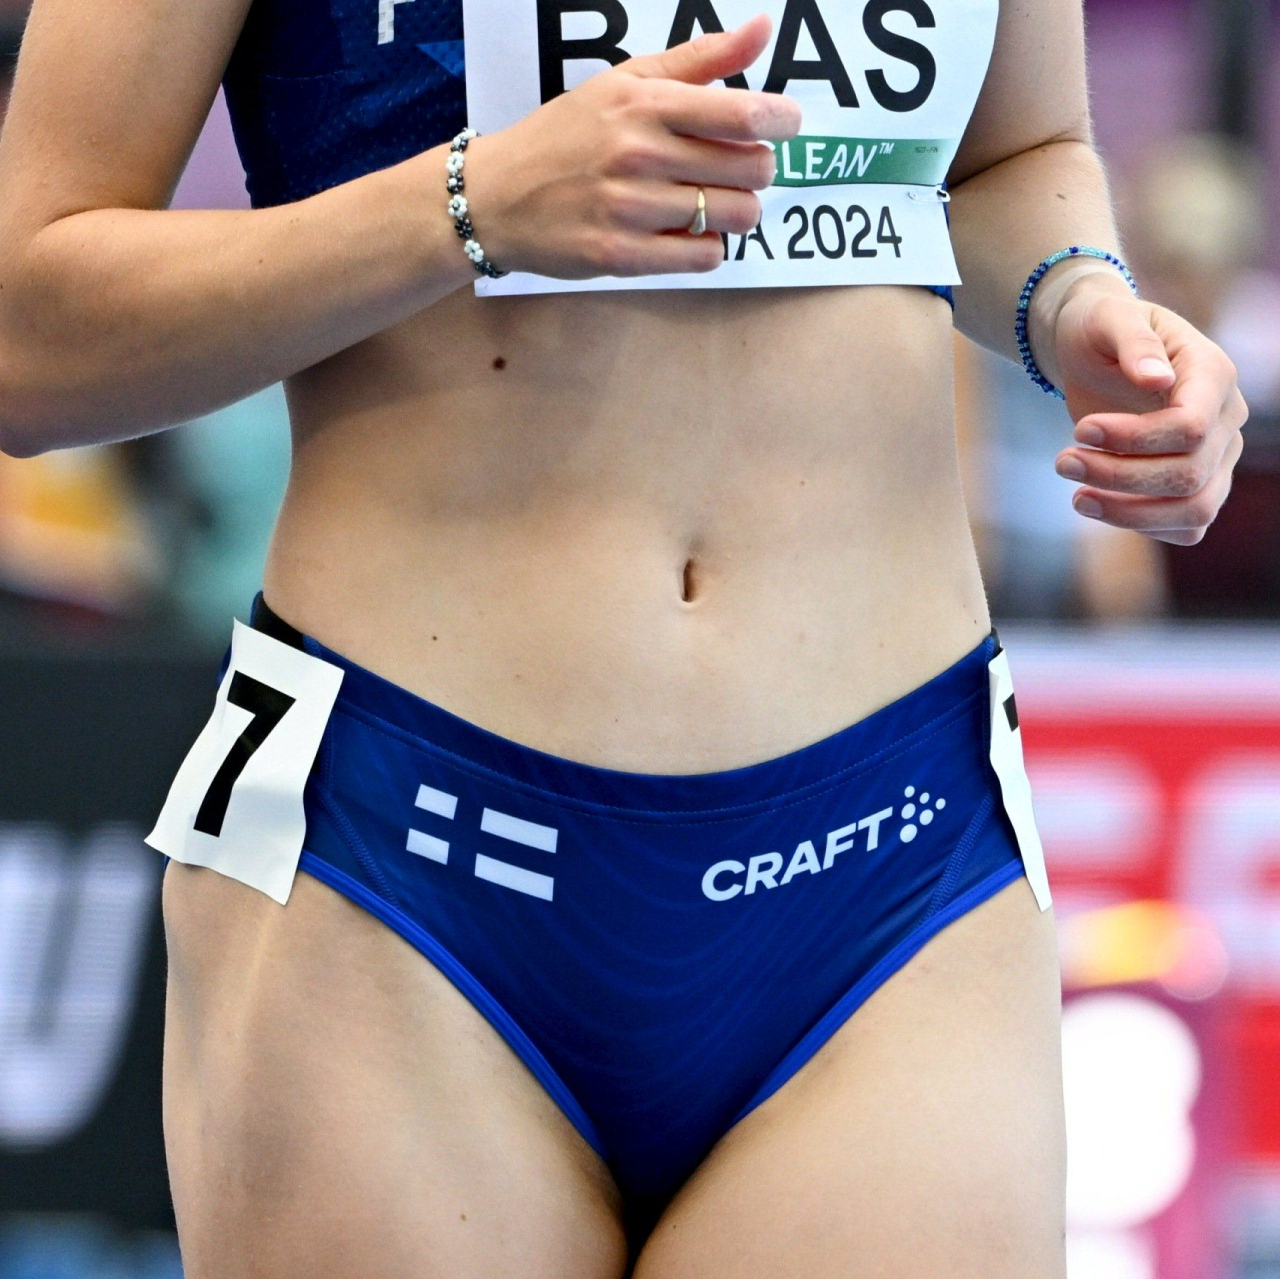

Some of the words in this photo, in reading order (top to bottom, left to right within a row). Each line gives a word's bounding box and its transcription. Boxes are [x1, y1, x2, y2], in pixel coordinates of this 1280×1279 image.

[783, 204, 903, 260] 2024
[193, 669, 297, 838] 7
[701, 806, 893, 902] CRAFT
